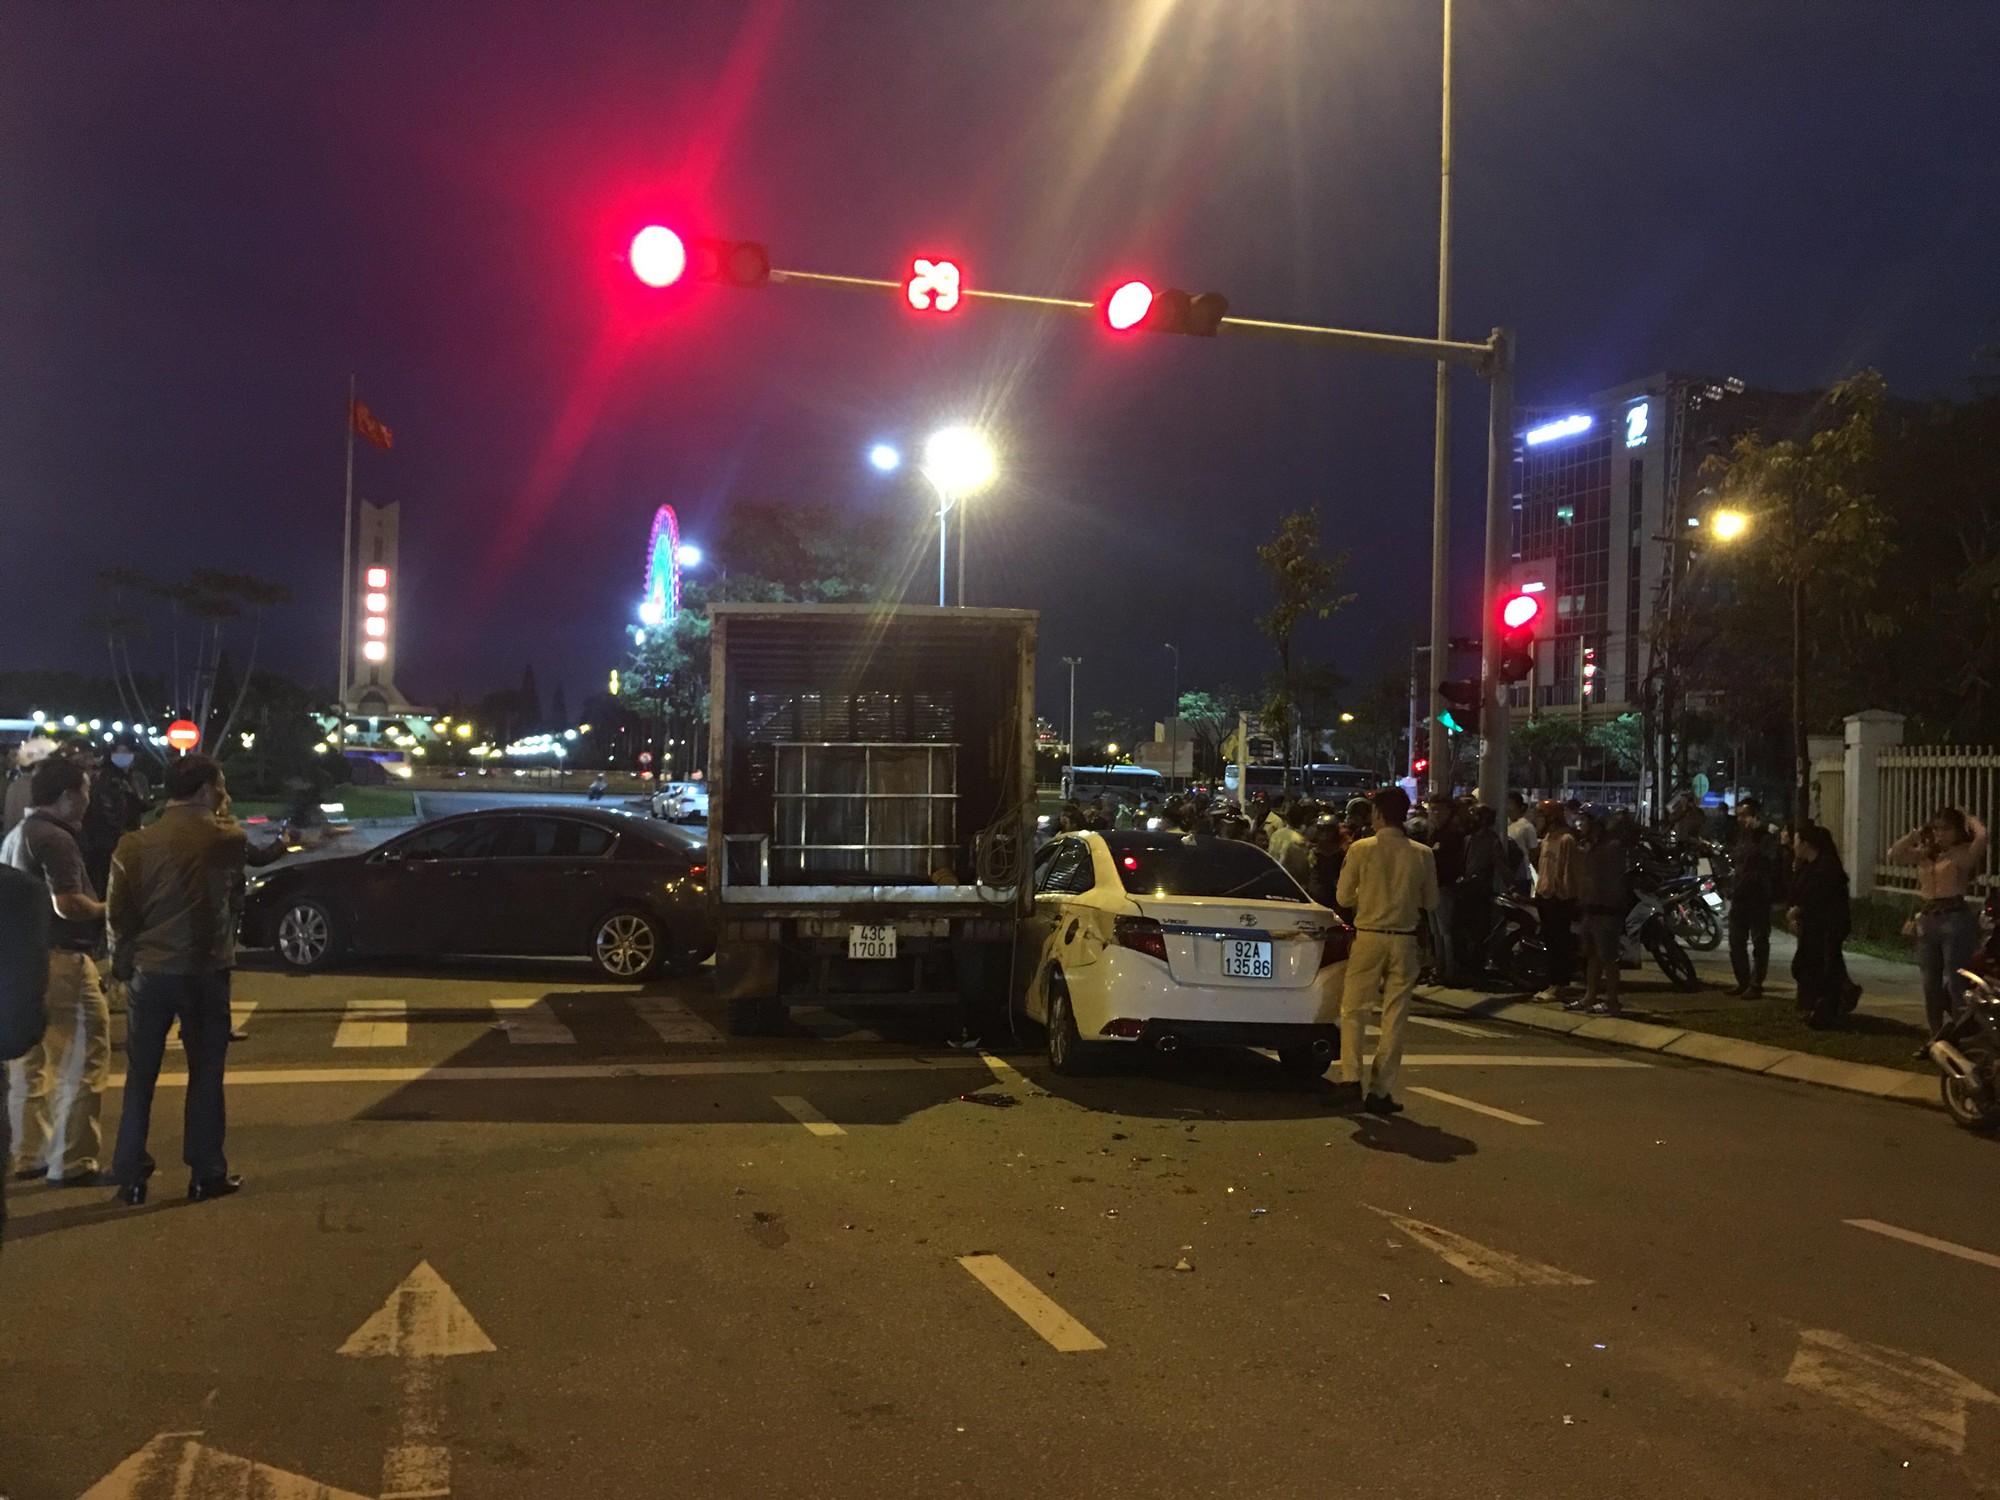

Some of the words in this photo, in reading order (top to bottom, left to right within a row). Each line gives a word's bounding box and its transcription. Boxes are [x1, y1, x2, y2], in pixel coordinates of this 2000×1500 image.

[861, 926, 886, 941] 43C
[852, 942, 894, 957] 170.01
[1235, 941, 1261, 958] 92A
[1226, 957, 1271, 976] 135.86
